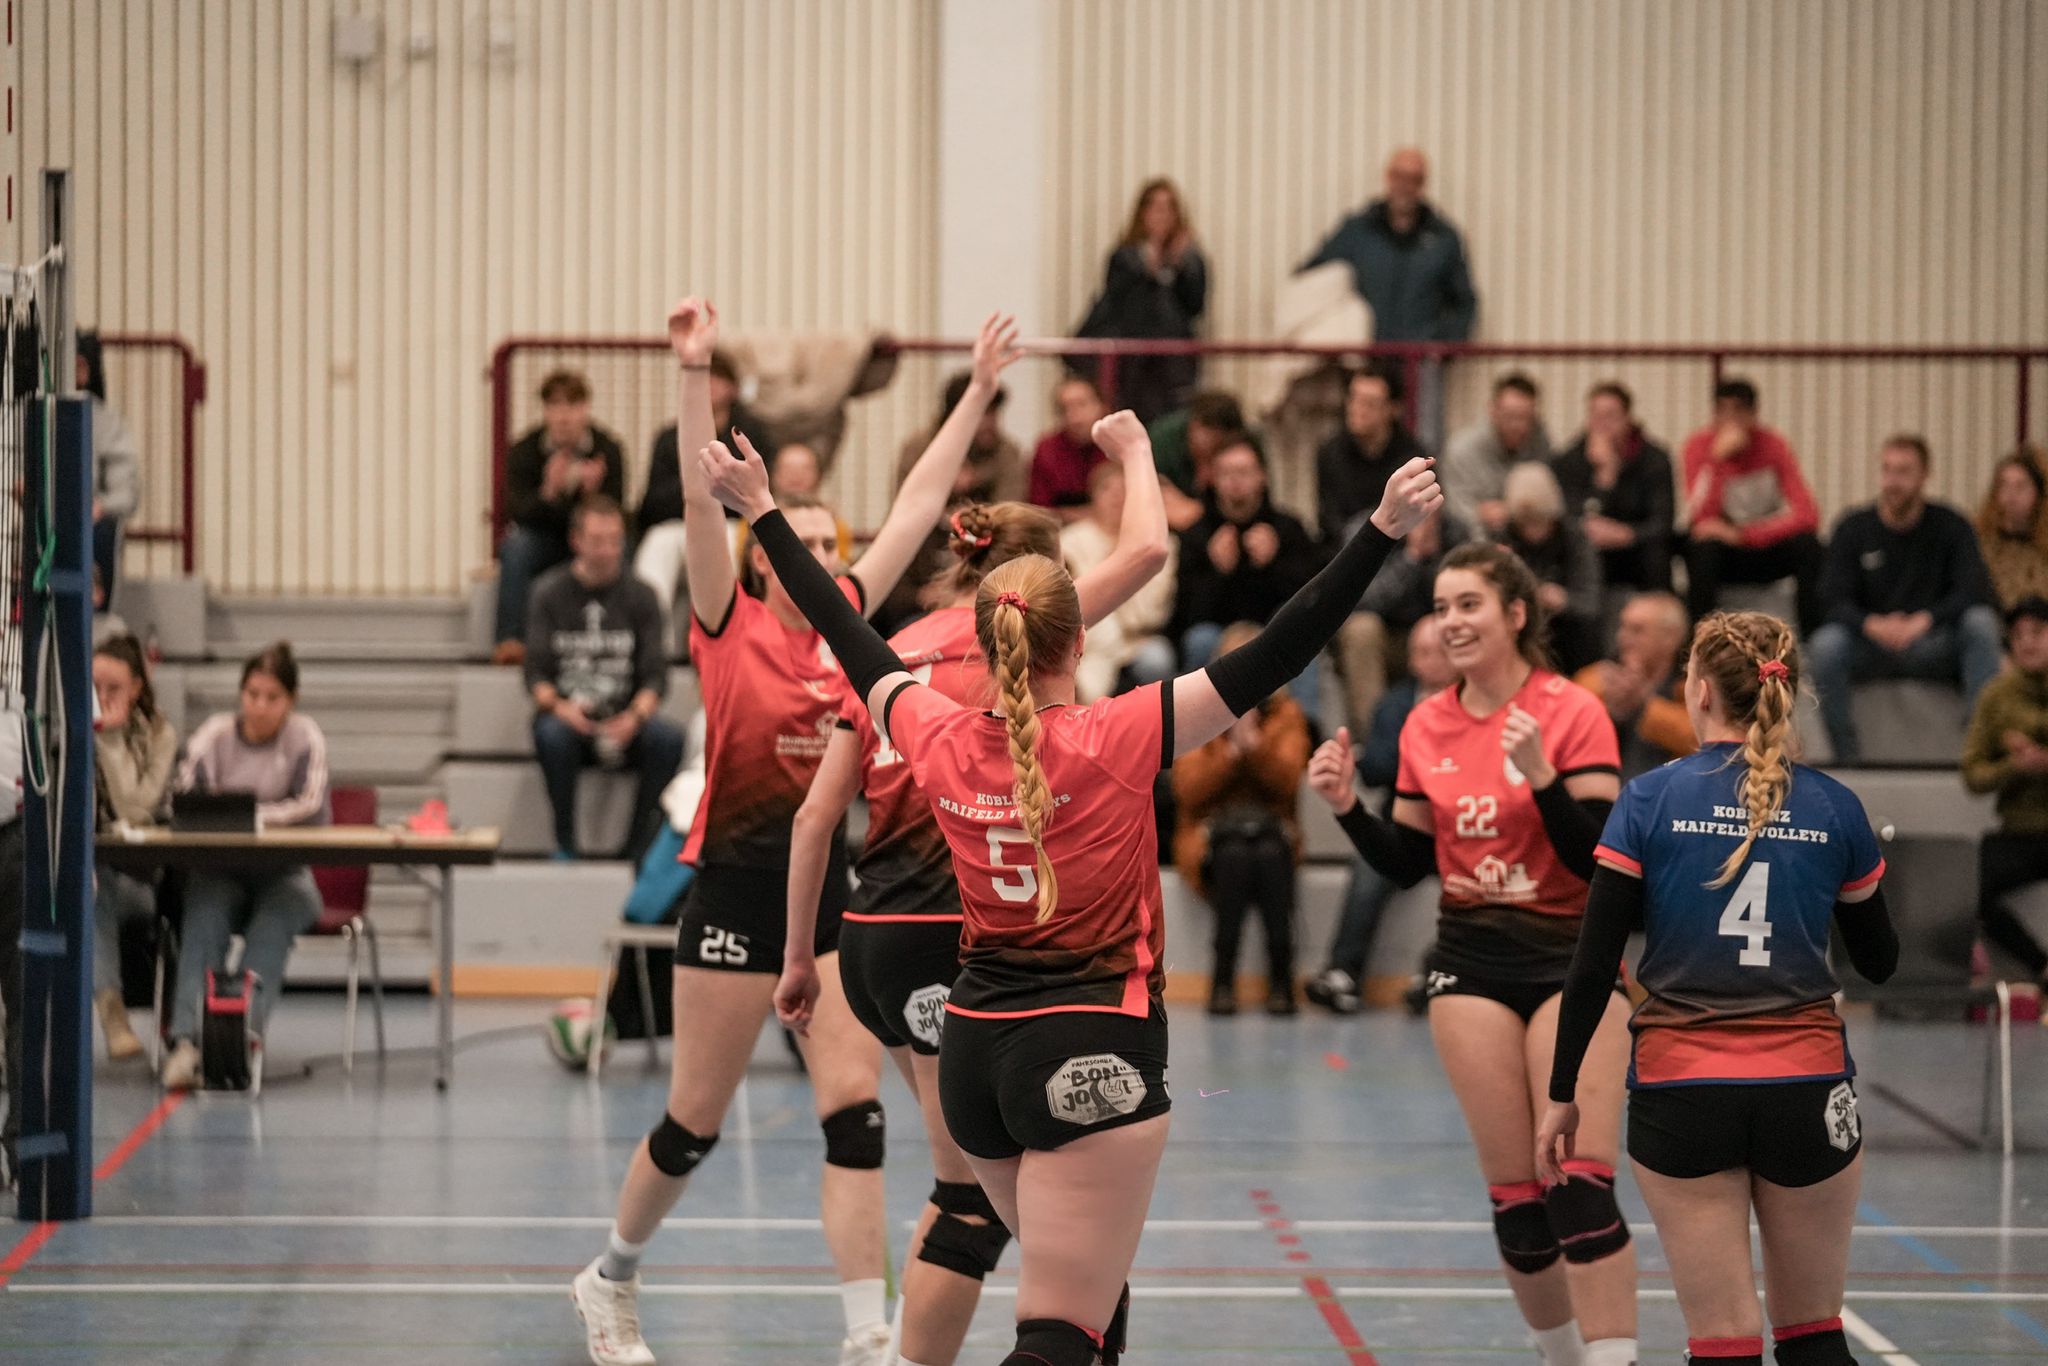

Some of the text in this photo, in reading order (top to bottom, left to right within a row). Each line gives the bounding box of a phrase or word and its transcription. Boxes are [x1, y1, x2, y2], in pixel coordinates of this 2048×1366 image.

[939, 797, 1005, 820] MAIFELD
[1456, 796, 1498, 837] 22
[1672, 820, 1828, 843] MAIFELD VOLLEYS
[986, 825, 1038, 902] 5
[1718, 861, 1772, 966] 4
[700, 925, 750, 965] 25
